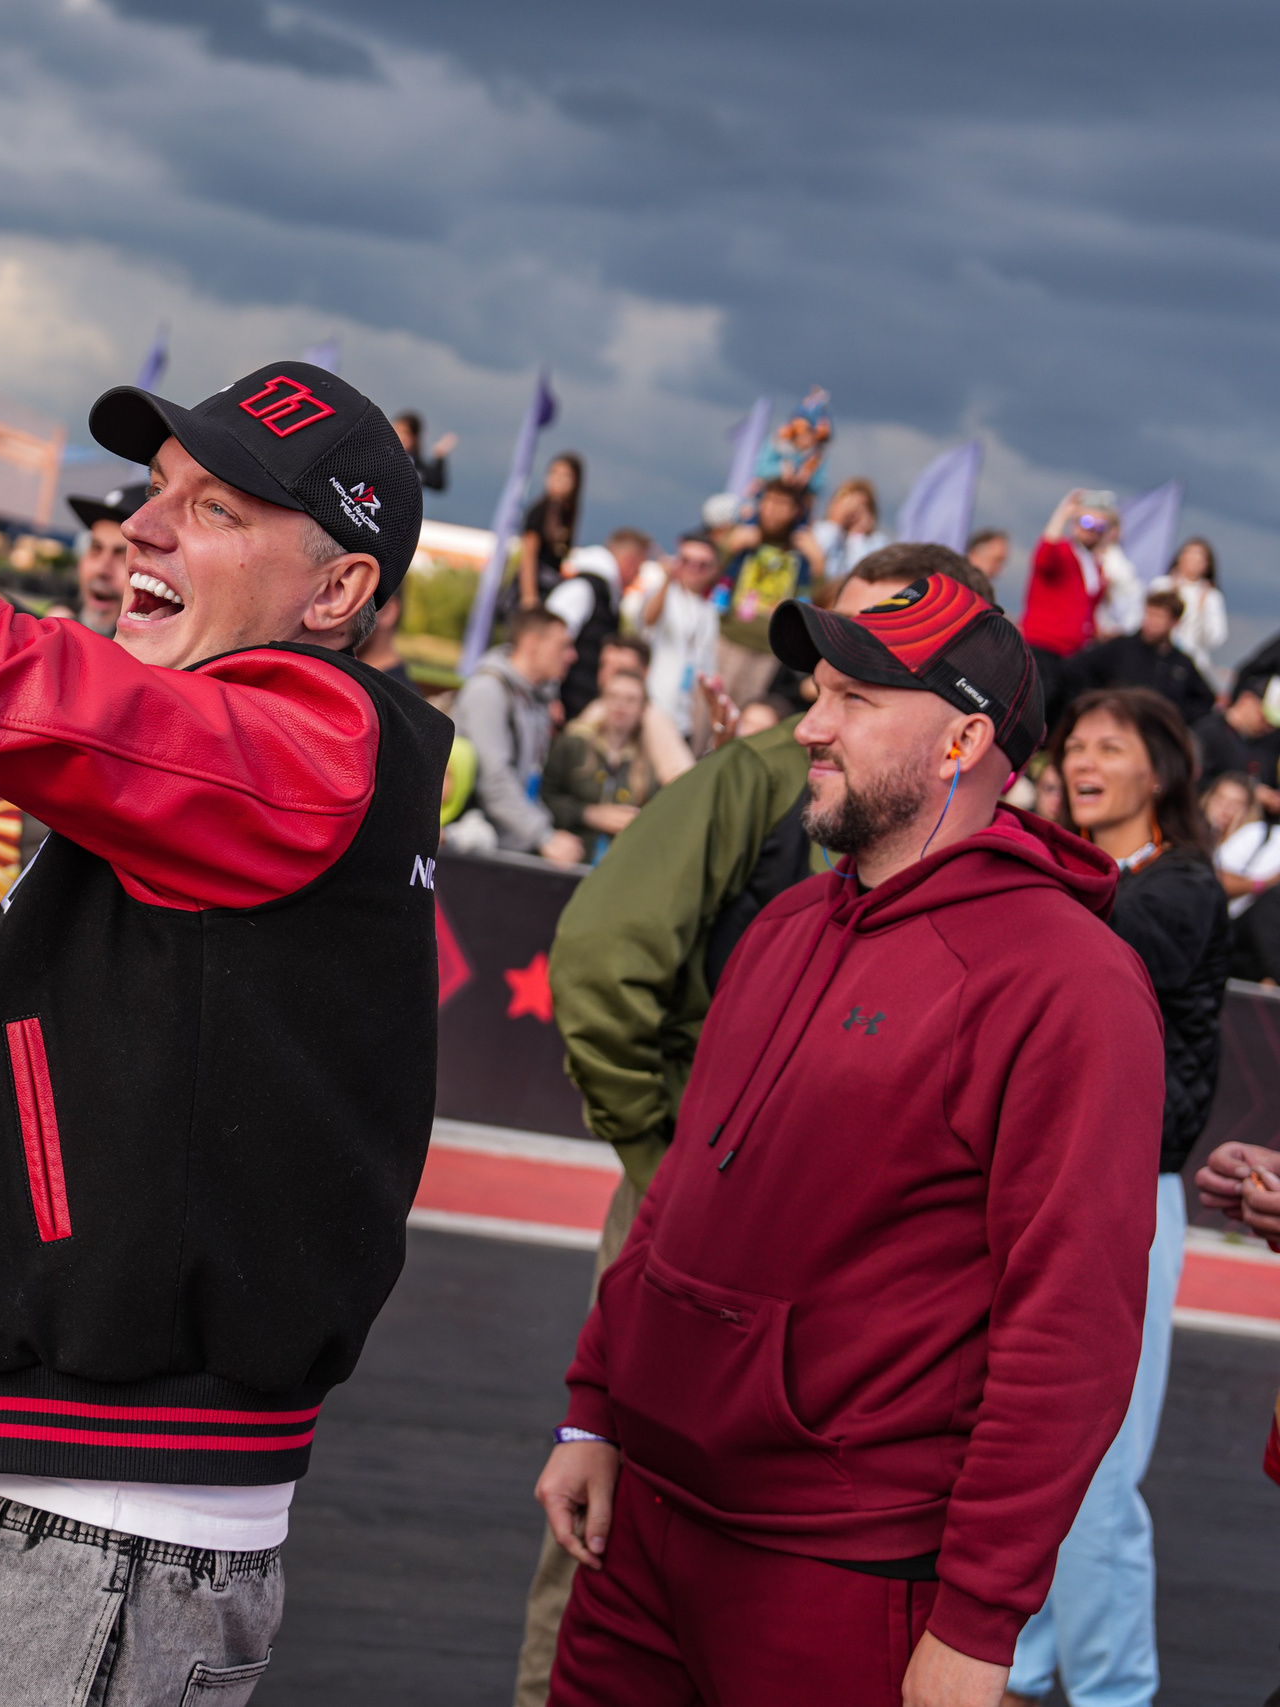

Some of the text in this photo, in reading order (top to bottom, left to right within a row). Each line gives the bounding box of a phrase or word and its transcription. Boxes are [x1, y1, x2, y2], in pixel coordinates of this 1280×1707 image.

[329, 476, 380, 533] NIGHT RACER
[340, 499, 363, 527] TEAM
